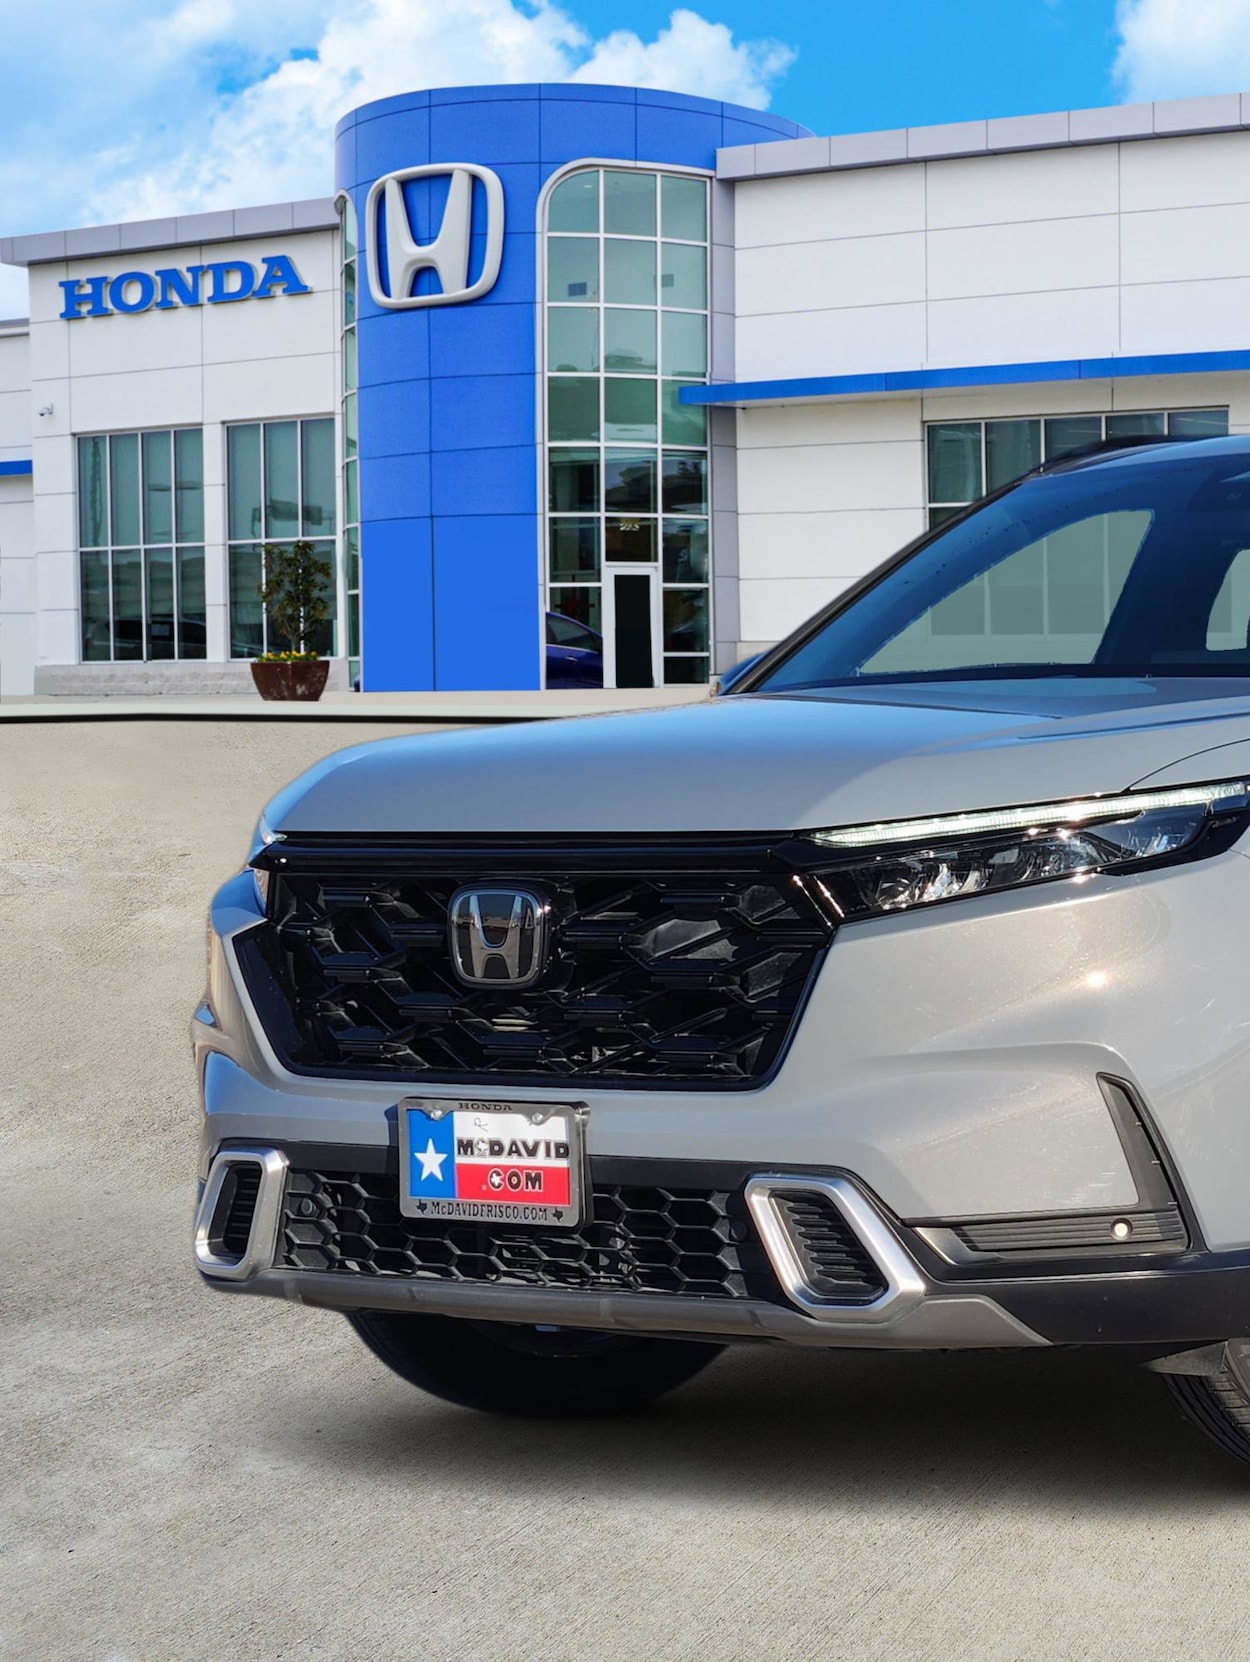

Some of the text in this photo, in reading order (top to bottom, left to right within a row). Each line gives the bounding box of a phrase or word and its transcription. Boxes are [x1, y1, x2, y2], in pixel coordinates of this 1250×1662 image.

[58, 254, 312, 320] HONDA
[458, 1102, 512, 1111] HONDA
[431, 1201, 548, 1221] McDAVIDFRISCO.COM
